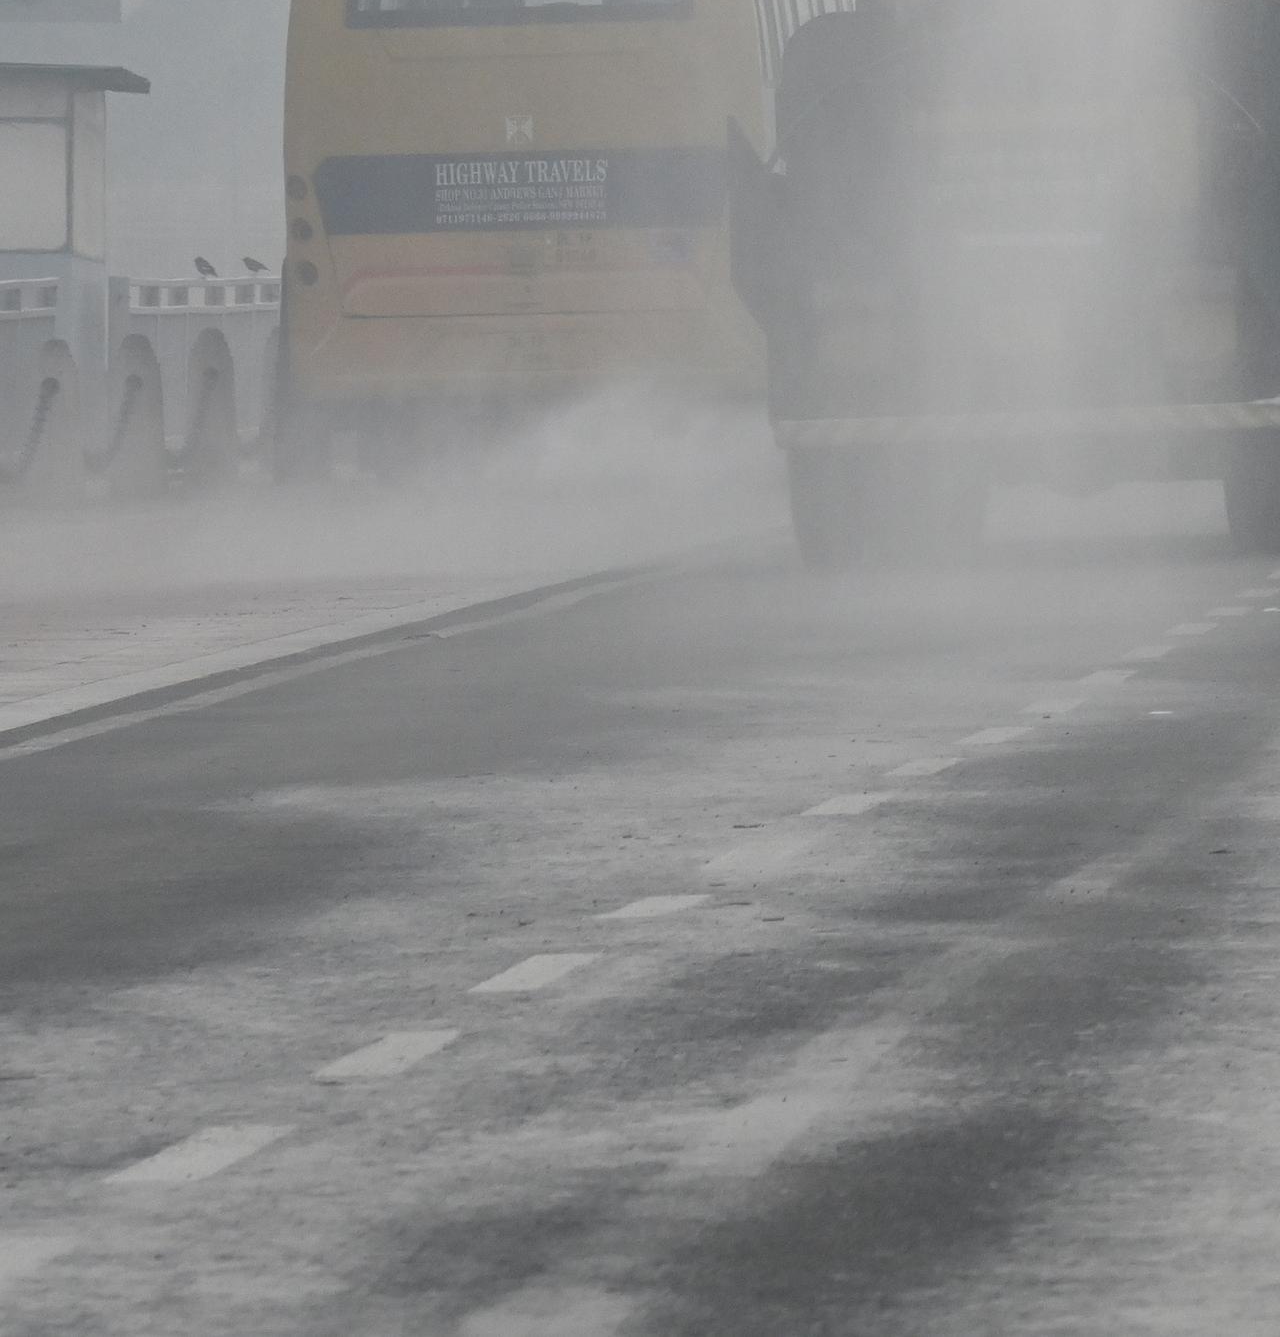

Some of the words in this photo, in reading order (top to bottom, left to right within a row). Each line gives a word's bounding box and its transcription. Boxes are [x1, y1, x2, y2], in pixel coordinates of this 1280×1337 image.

[435, 162, 520, 186] HIGHWAY
[524, 159, 608, 183] TRAVELS
[435, 189, 460, 202] SHOP
